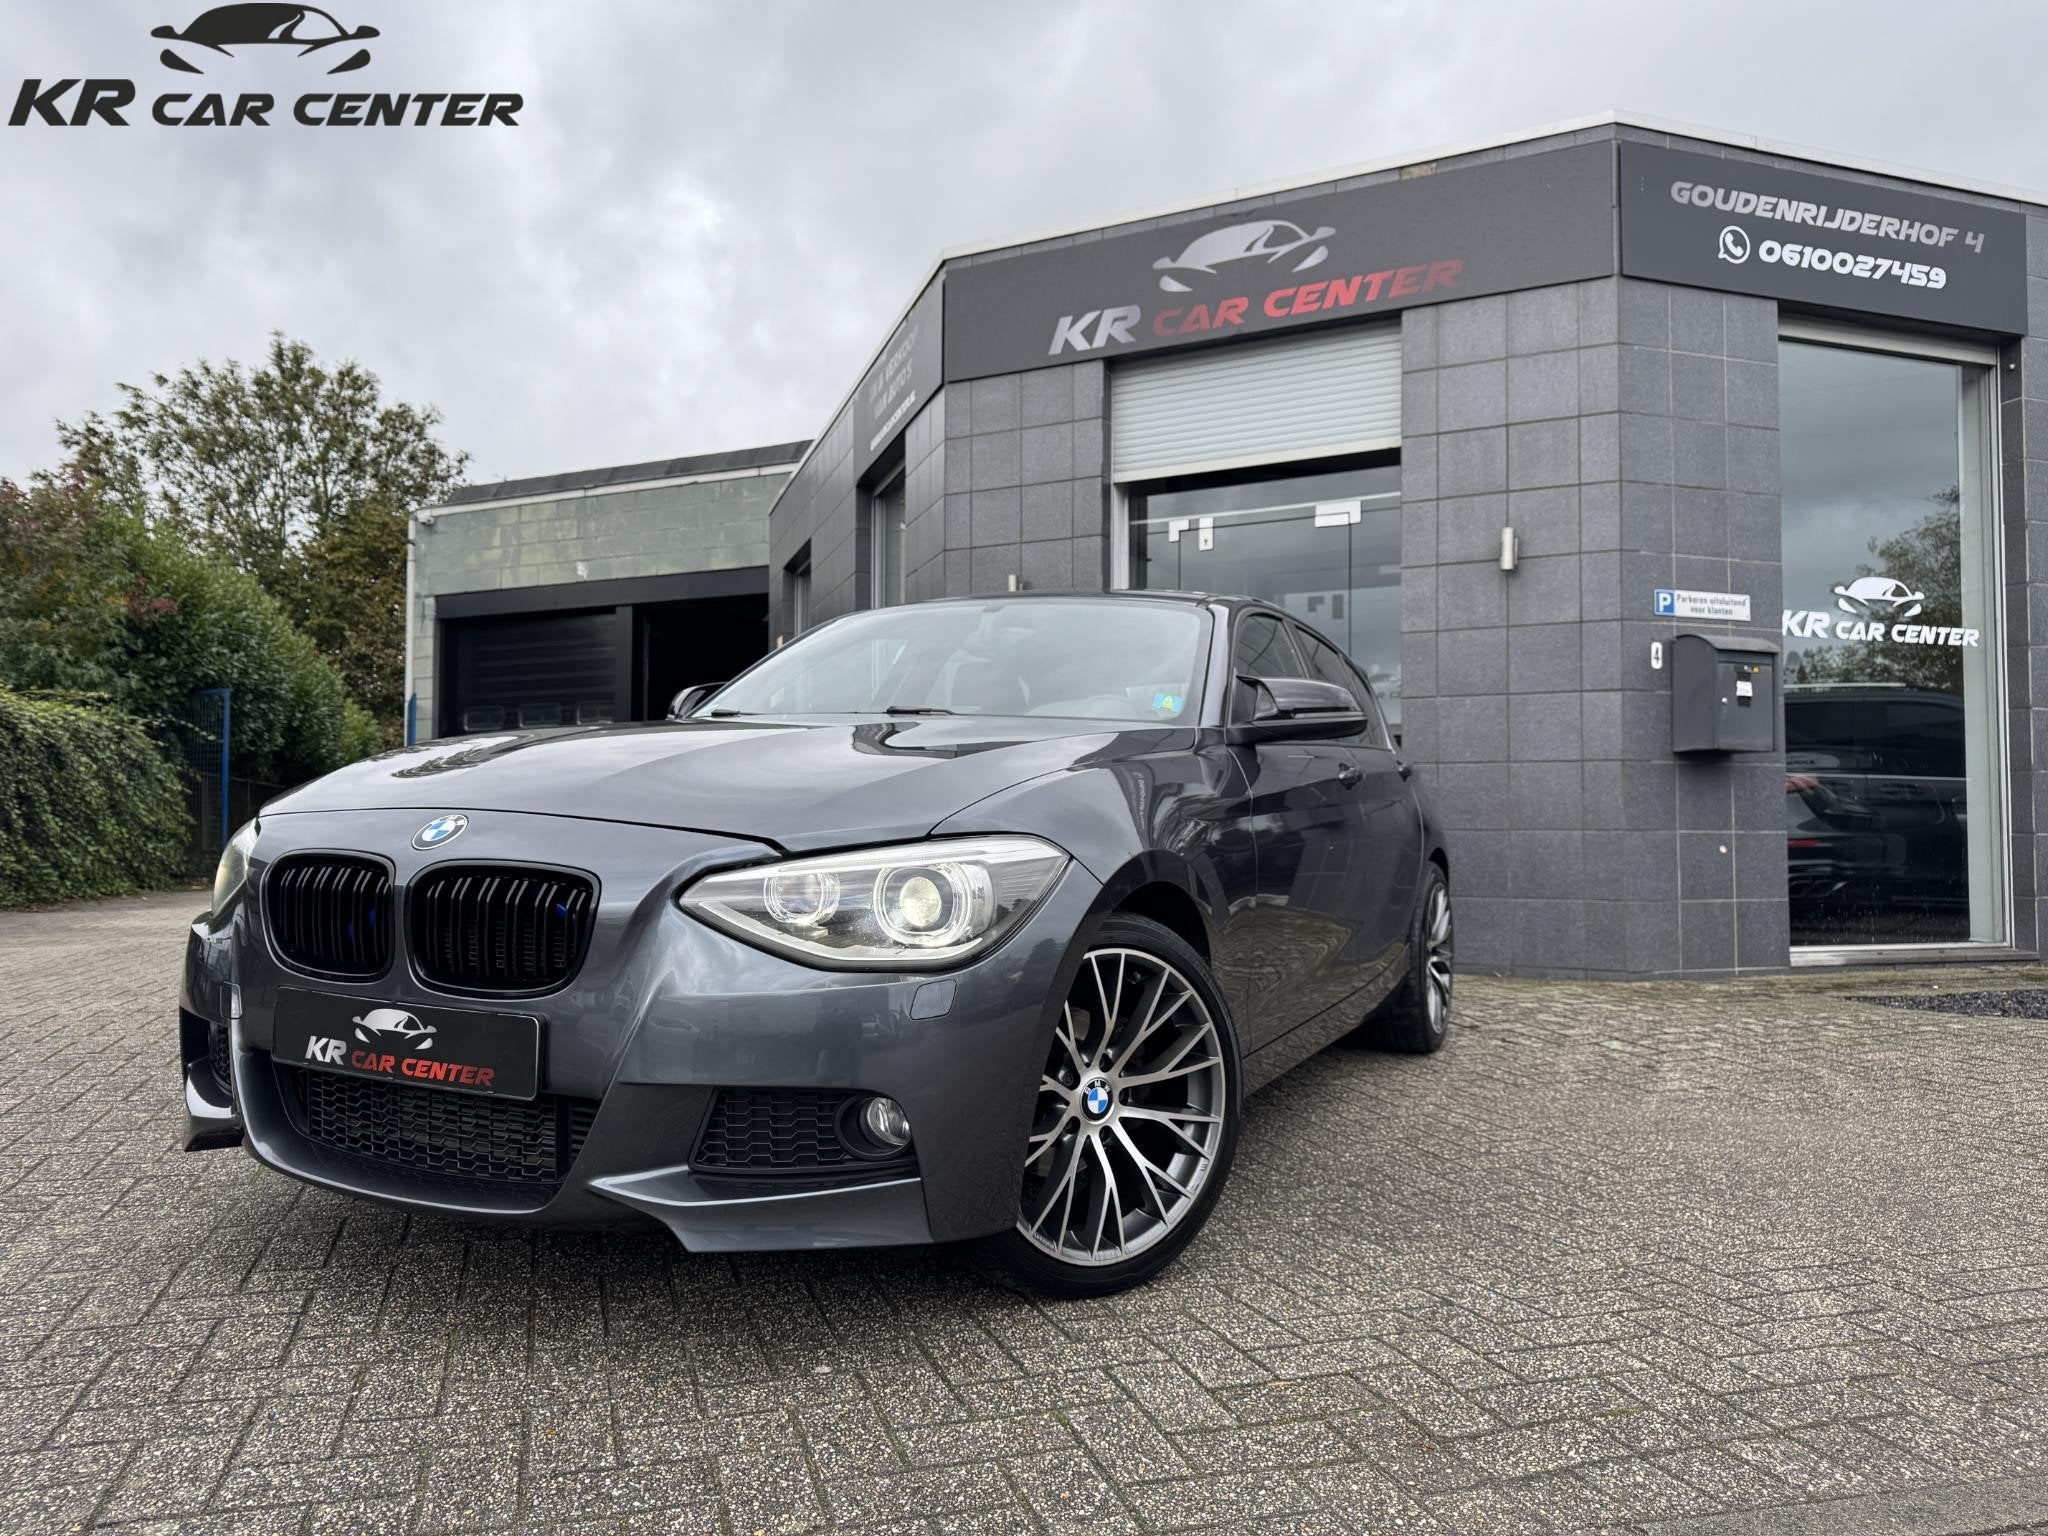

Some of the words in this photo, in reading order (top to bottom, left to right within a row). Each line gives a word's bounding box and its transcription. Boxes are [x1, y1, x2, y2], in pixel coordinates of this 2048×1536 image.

[1670, 180, 1960, 248] GOUDENRIJDERHOF
[1965, 232, 1986, 254] 4
[1758, 239, 1947, 290] 0610027459
[1048, 304, 1142, 356] KR
[1152, 295, 1249, 337] CAR
[1263, 258, 1465, 319] CENTER
[1783, 609, 1831, 639] KR
[1835, 620, 1885, 642] CAR
[1891, 623, 1980, 647] CENTER
[305, 1035, 347, 1066] KR
[351, 1050, 396, 1074] CAR
[401, 1058, 496, 1087] CENTER
